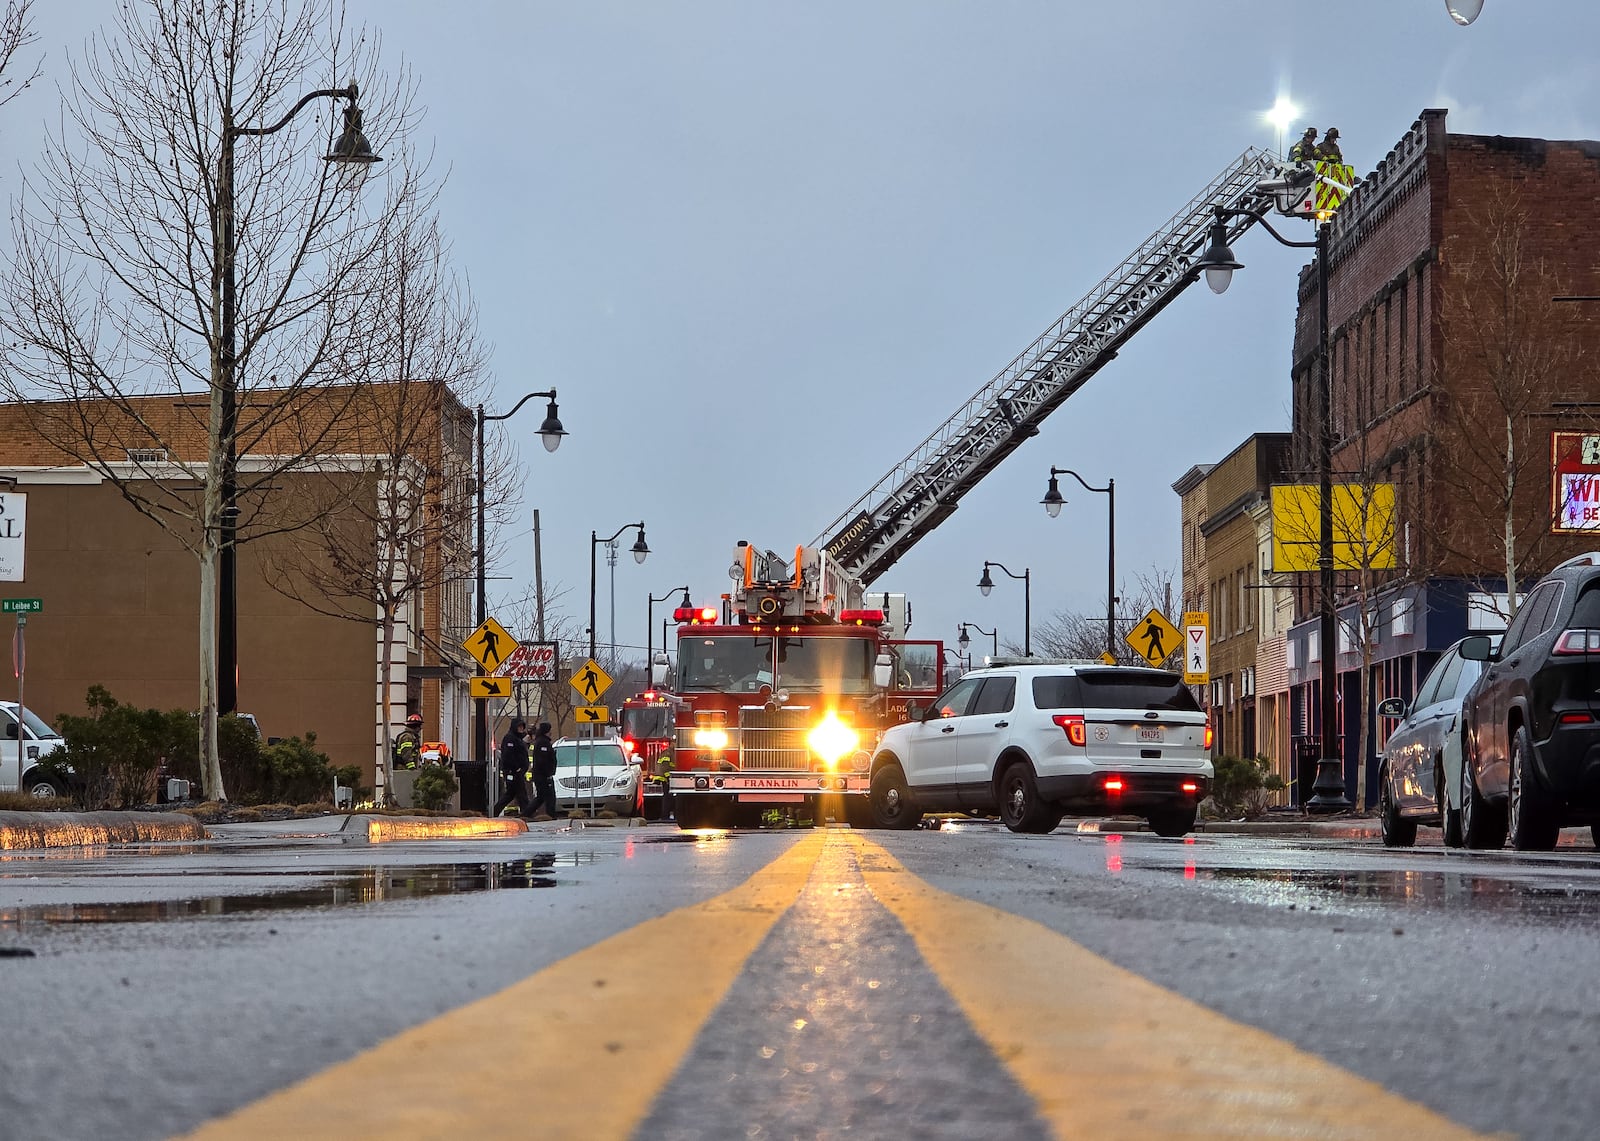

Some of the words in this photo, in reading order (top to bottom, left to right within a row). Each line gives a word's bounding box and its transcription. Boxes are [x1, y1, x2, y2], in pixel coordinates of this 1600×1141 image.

[3, 601, 9, 610] N
[12, 601, 31, 610] Leibee
[33, 600, 40, 610] St
[744, 779, 799, 787] FRANKLIN
